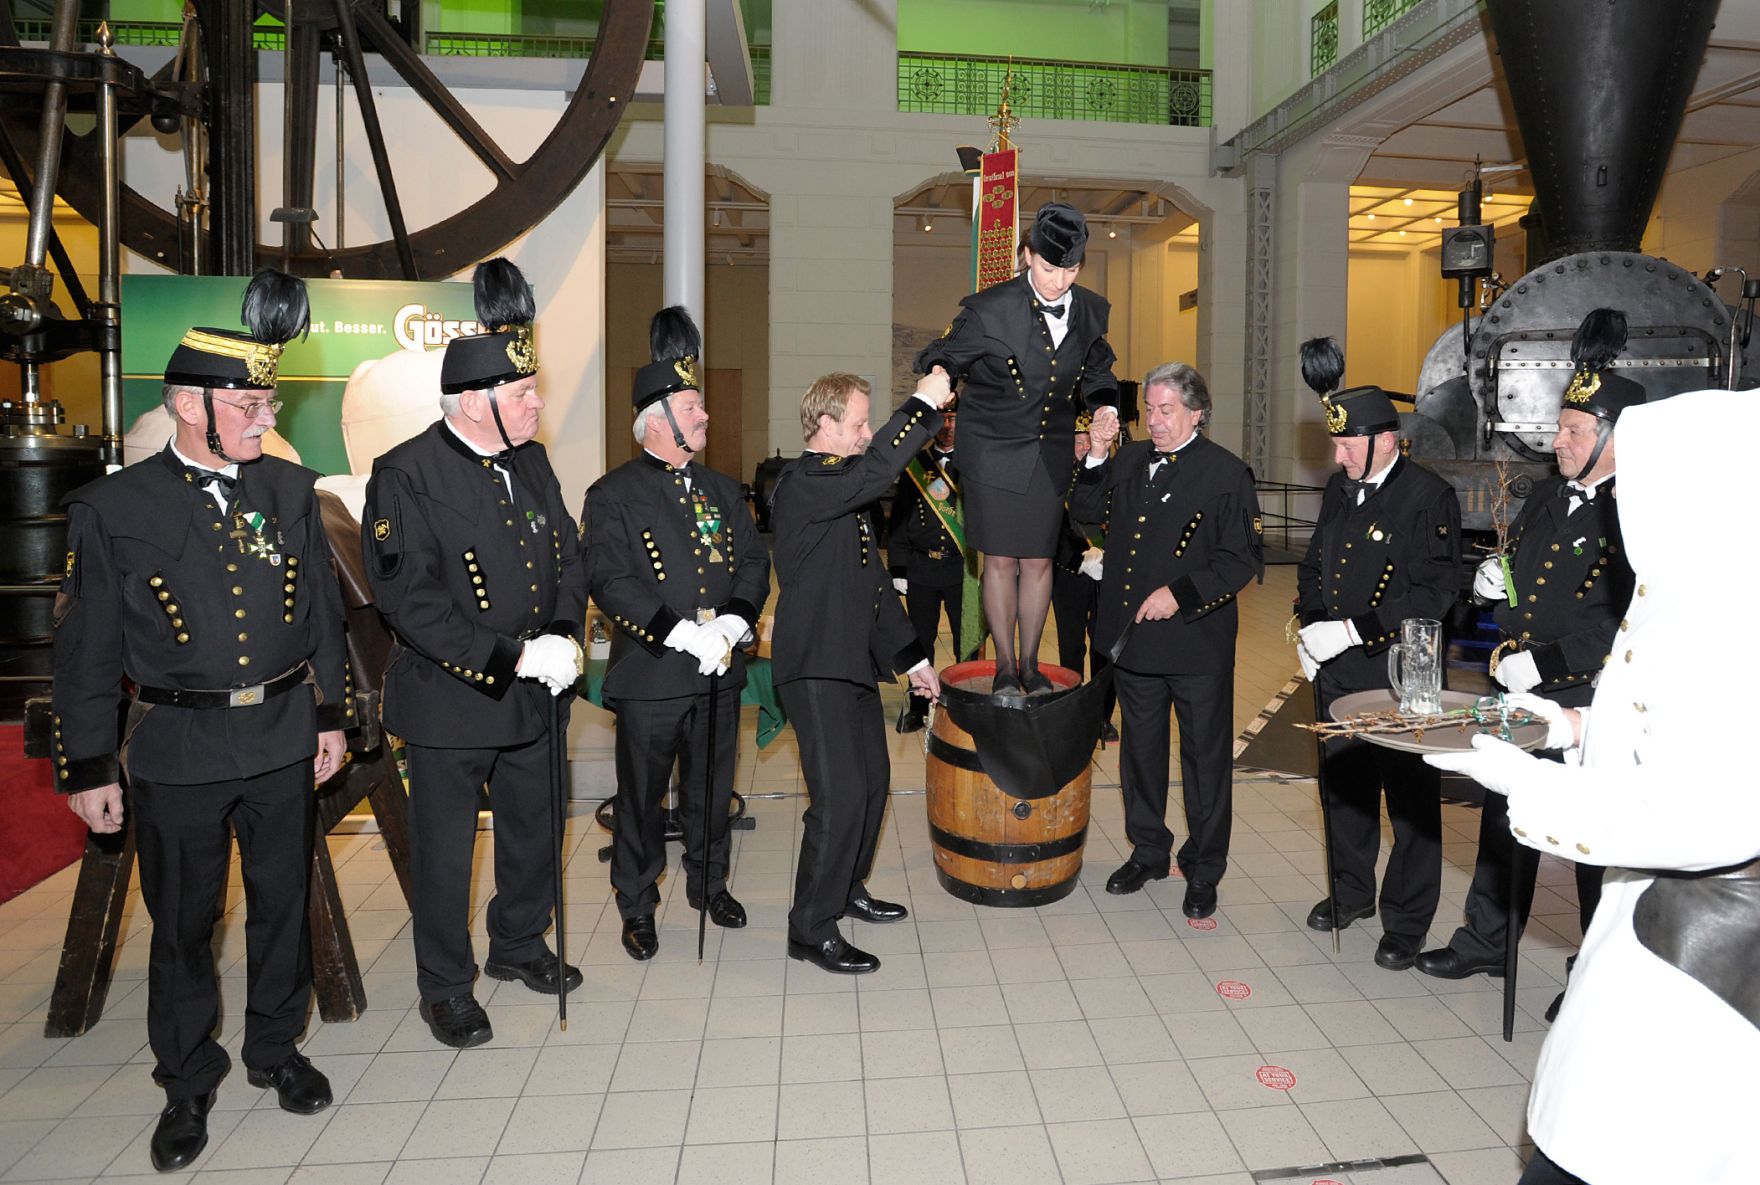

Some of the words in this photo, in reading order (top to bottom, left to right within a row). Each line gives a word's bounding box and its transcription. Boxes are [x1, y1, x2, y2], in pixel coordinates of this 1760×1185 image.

[302, 320, 330, 333] ut.
[334, 320, 387, 334] Besser.
[393, 303, 511, 351] Göss
